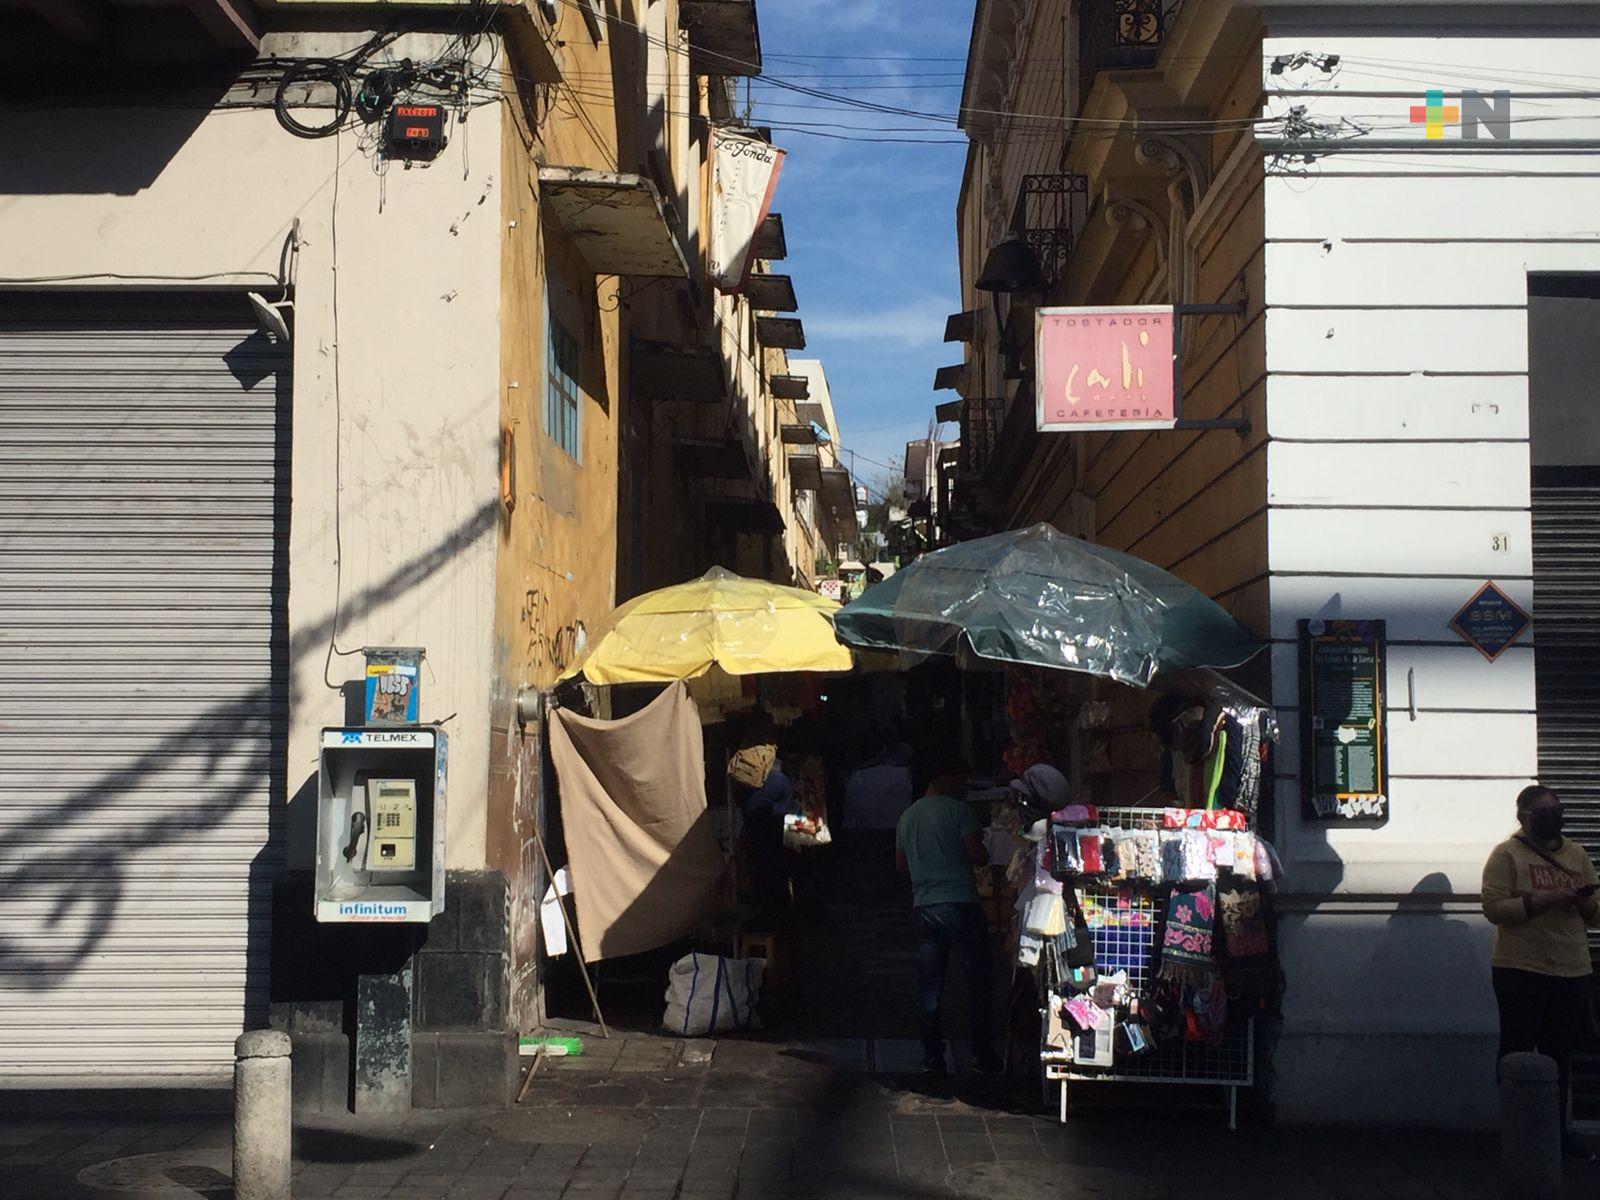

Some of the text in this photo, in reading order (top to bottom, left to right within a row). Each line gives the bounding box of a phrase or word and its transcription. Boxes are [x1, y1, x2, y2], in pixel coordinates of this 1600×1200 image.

[714, 138, 773, 164] La Fonda
[1054, 318, 1162, 327] TOSTADOR
[1492, 535, 1508, 552] 31
[366, 734, 417, 742] TELMEX
[339, 903, 407, 914] infinitum
